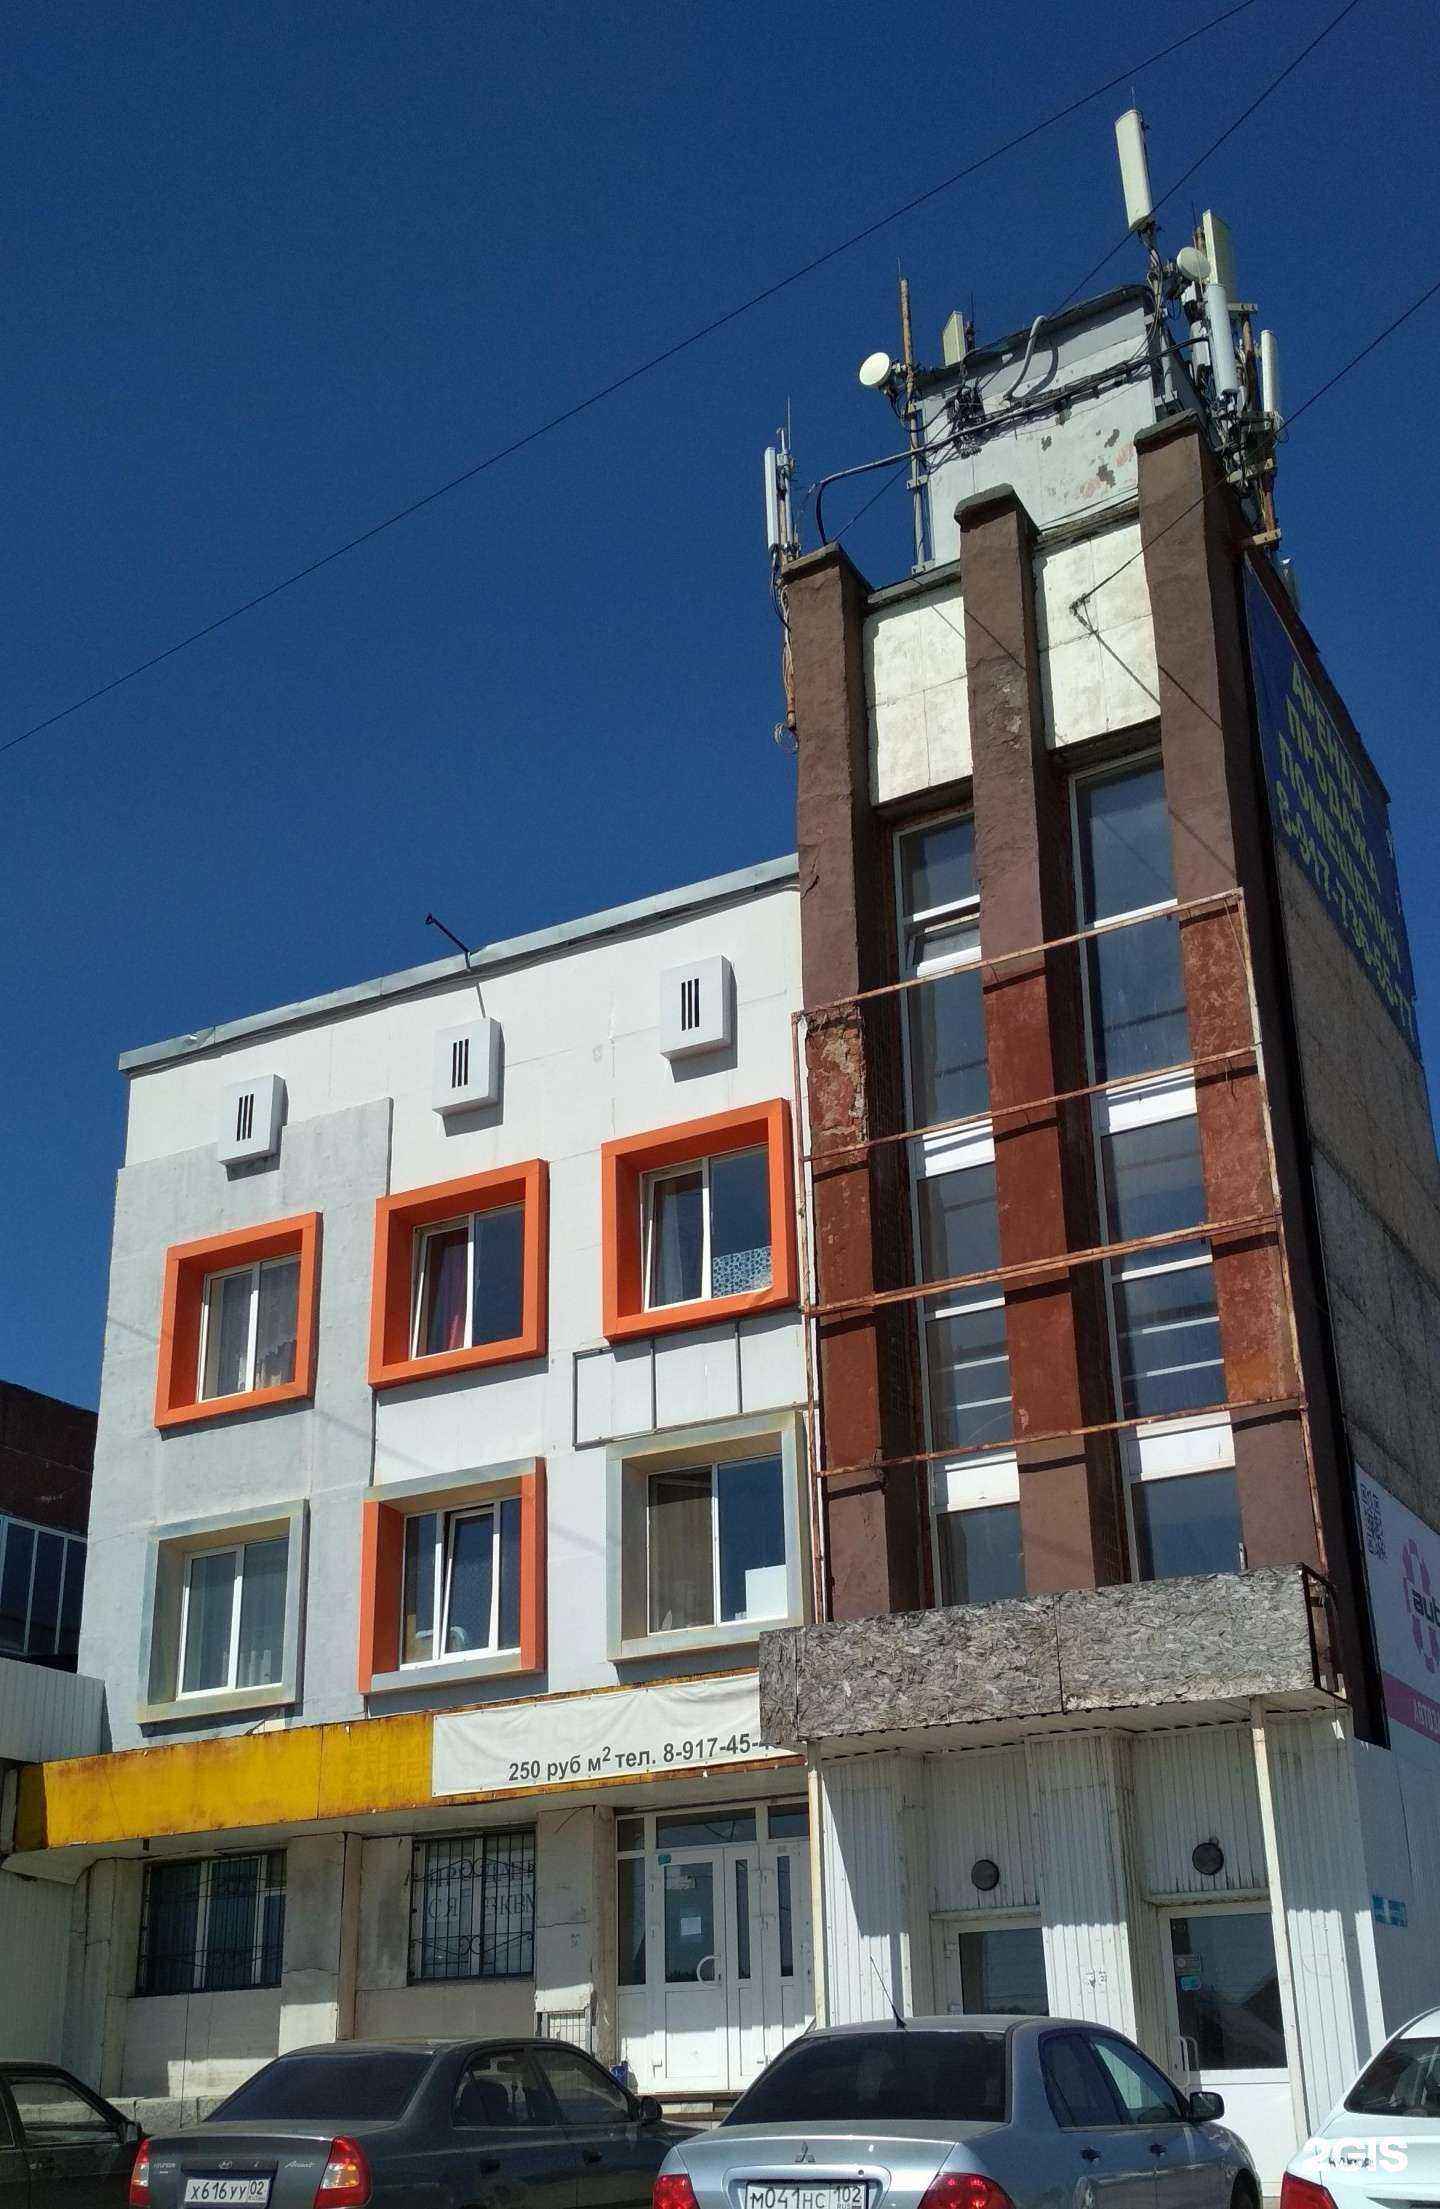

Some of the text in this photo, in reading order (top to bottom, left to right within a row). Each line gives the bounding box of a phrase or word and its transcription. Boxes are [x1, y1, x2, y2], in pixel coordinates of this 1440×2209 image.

[509, 1760, 540, 1781] 250
[547, 1754, 581, 1780] руб
[615, 1750, 656, 1768] тел.
